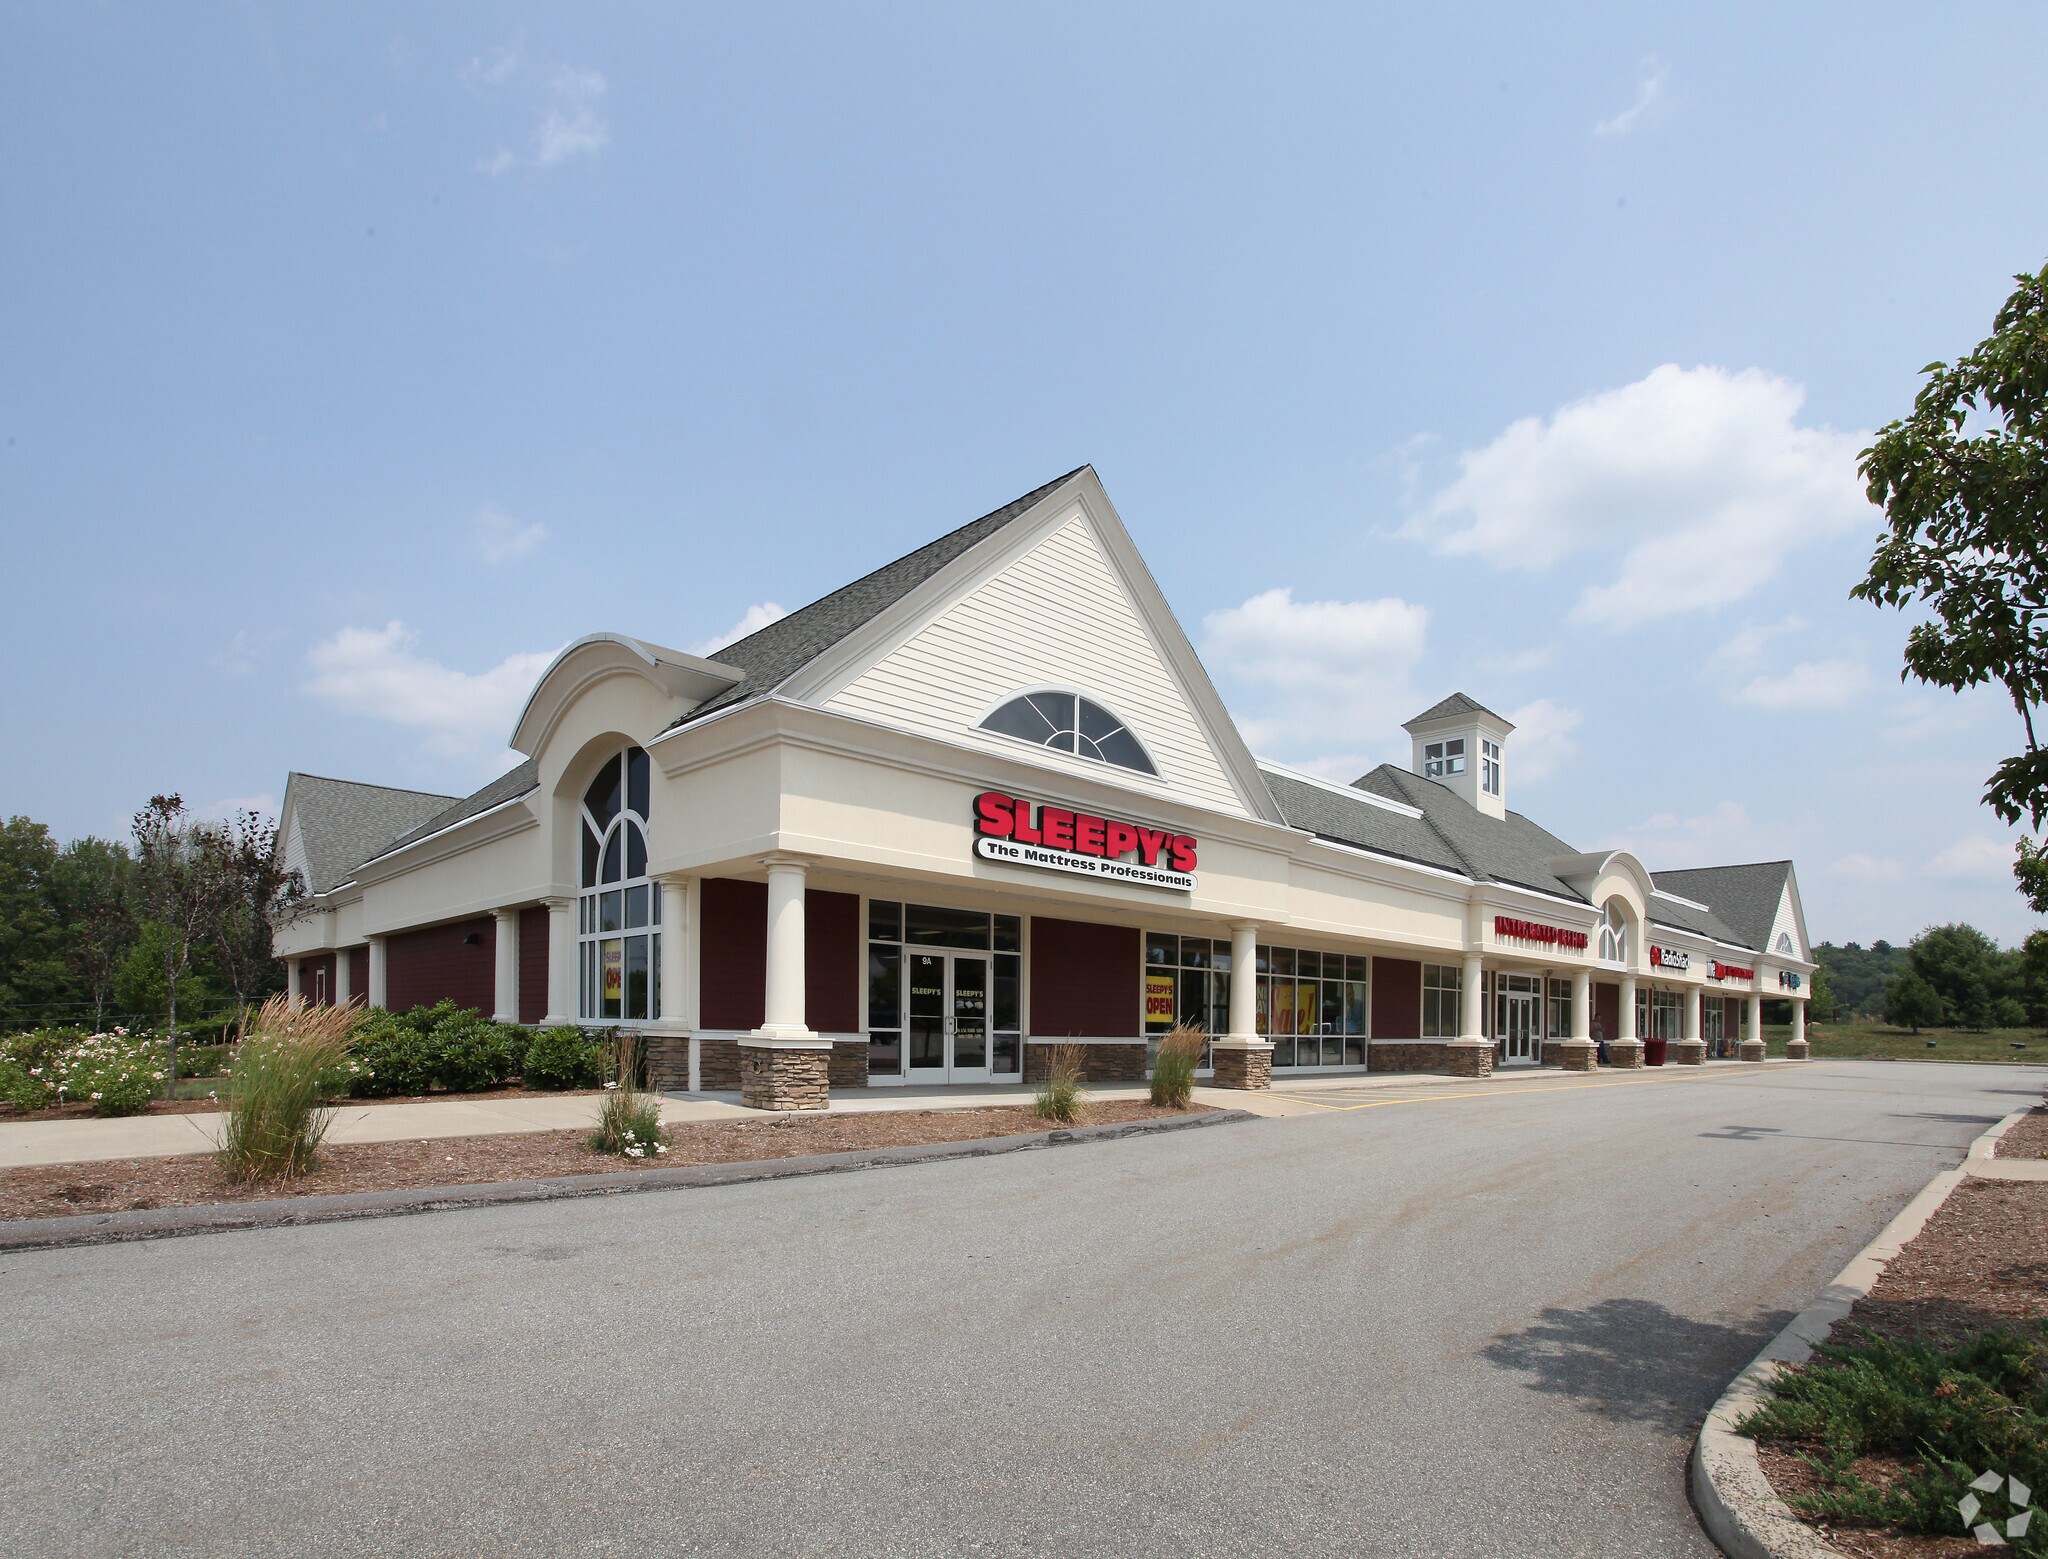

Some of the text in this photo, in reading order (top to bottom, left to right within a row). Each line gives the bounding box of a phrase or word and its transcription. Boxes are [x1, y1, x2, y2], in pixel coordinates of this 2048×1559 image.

[973, 792, 1197, 872] SLEEPY'S
[987, 842, 1192, 887] The Mattress Professionals
[922, 957, 931, 965] 9A
[606, 967, 621, 989] OPE
[911, 987, 941, 996] SLEEPY'S
[1146, 983, 1173, 995] SLEEPY'S
[1146, 997, 1173, 1015] OPEN
